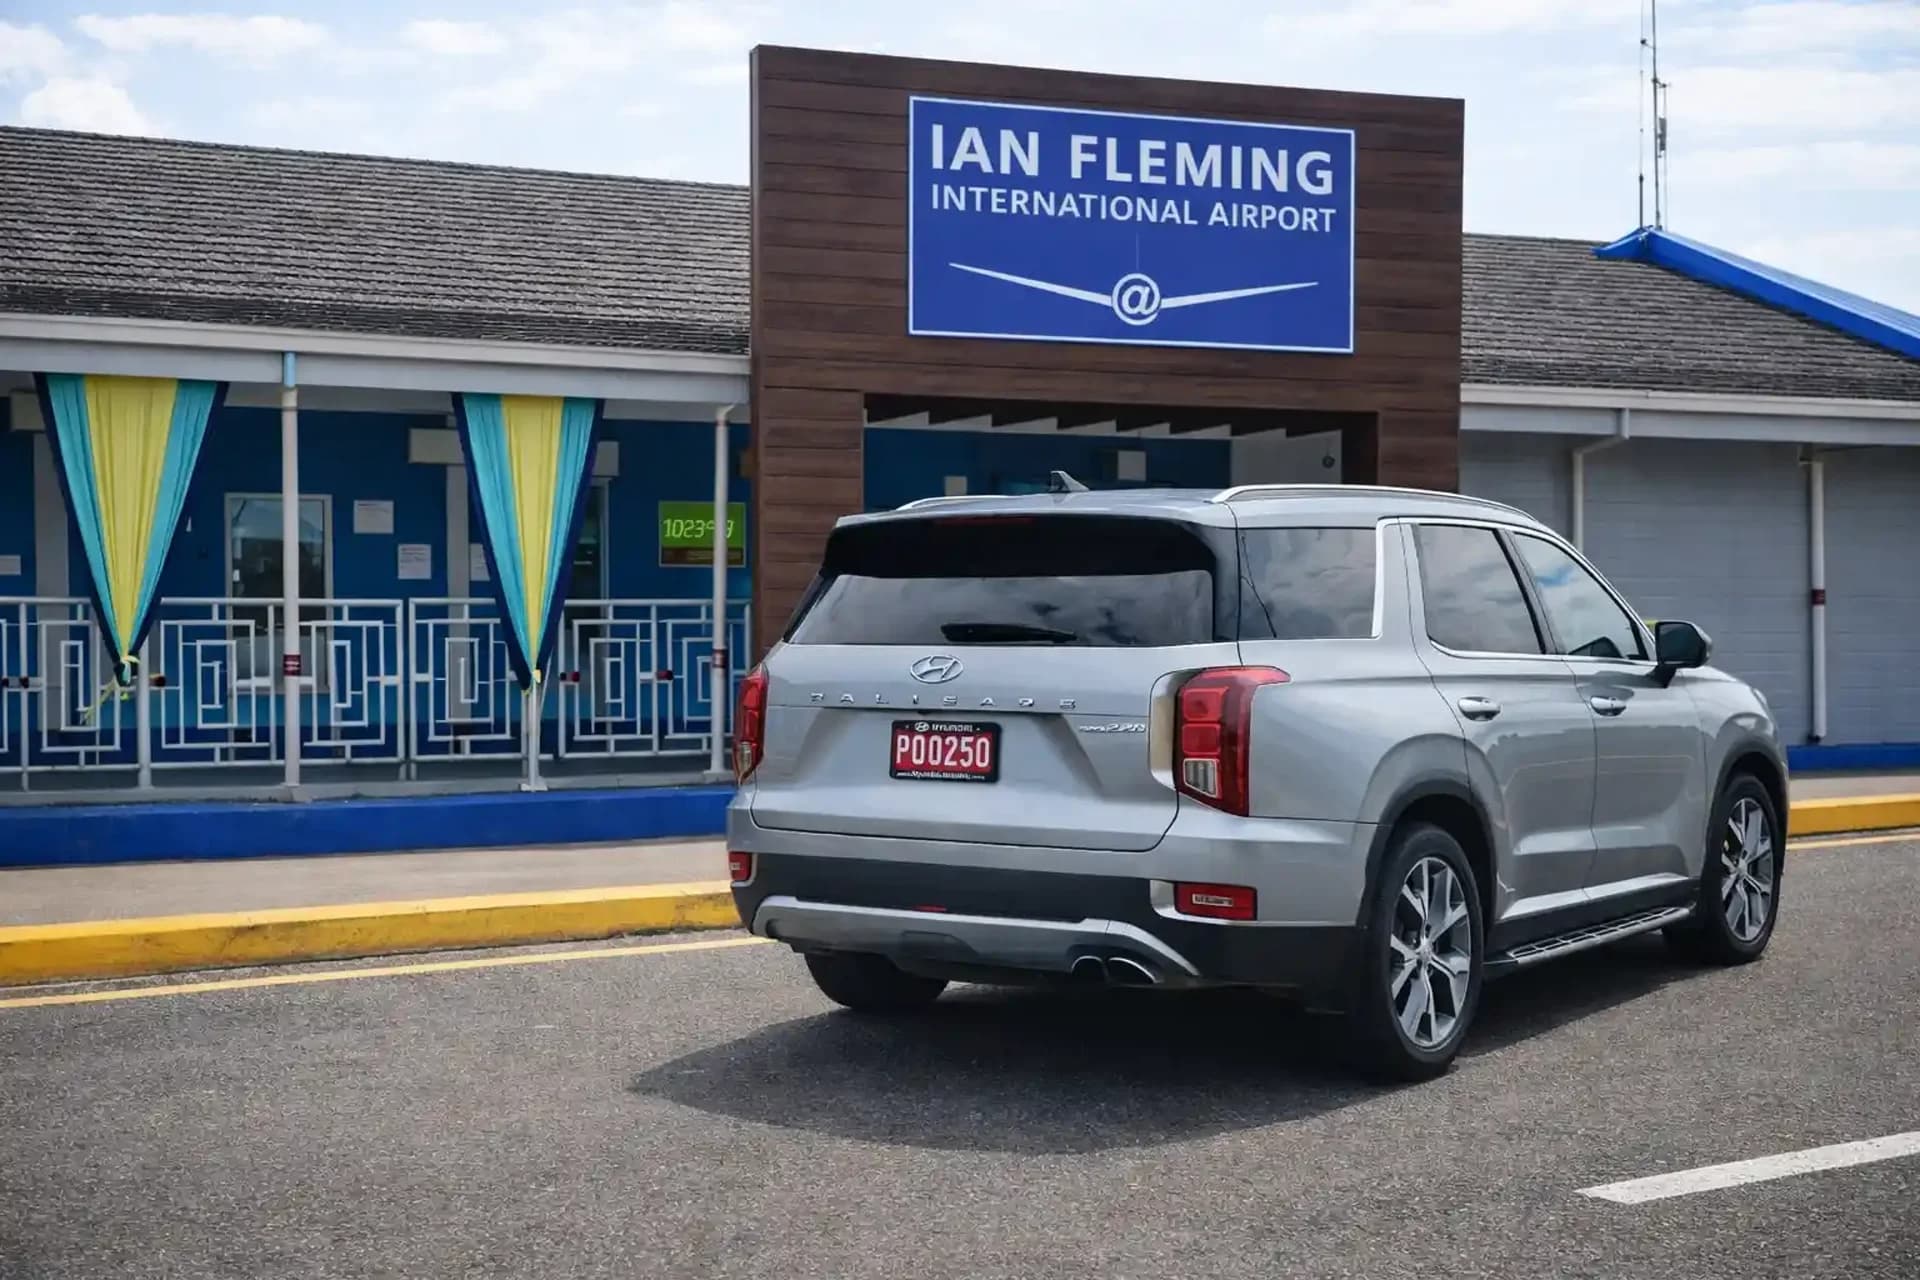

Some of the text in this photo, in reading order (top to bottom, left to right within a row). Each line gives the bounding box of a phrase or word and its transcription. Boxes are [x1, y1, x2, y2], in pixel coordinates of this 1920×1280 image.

[931, 123, 1334, 196] IAN FLEMING
[931, 183, 1337, 233] INTERNATIONAL AIRPORT
[895, 734, 991, 768] P00250
